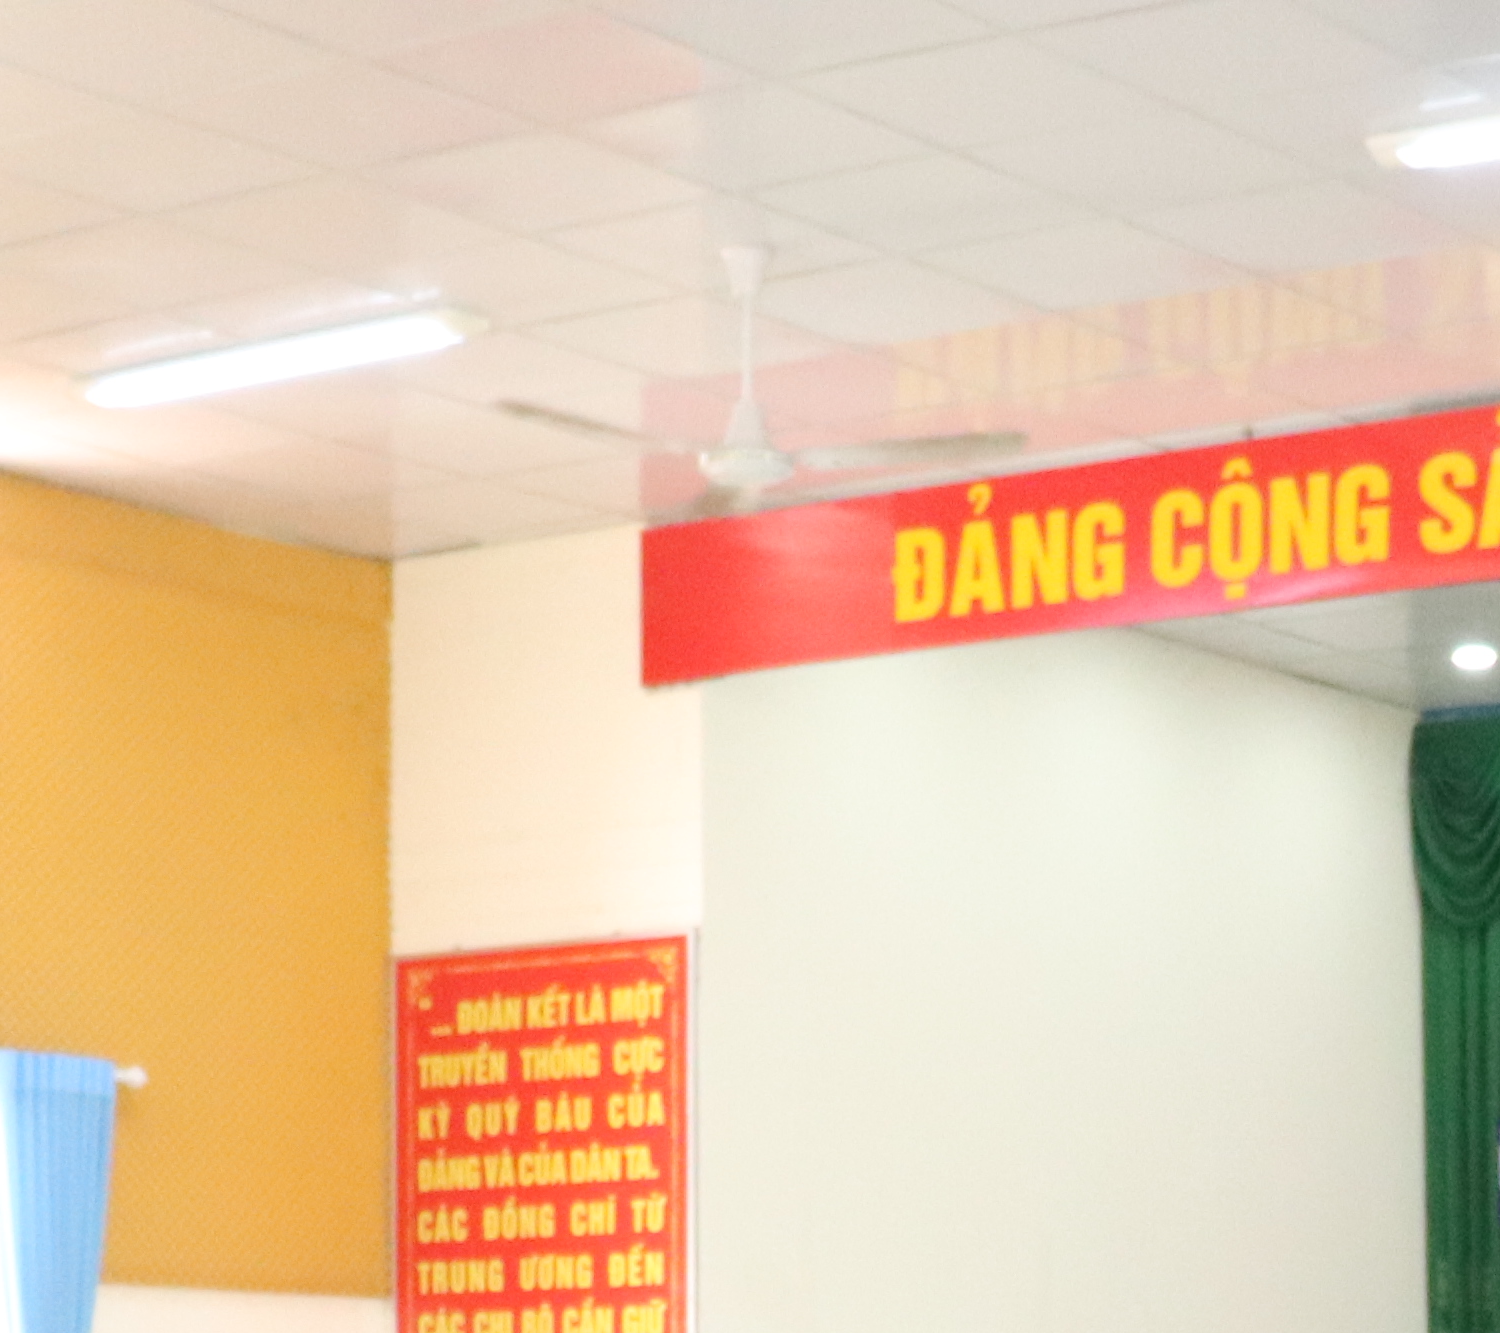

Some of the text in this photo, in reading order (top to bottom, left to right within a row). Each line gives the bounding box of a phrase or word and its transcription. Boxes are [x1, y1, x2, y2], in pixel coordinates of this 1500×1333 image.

[892, 483, 1126, 626] ĐẢNG
[1147, 456, 1390, 602] CỘNG
[527, 984, 571, 1028] KẾT
[575, 984, 606, 1022] LÀ
[611, 980, 665, 1027] MỘT
[520, 1035, 601, 1080] THỐNG
[612, 1035, 665, 1080] CỰC
[535, 1091, 593, 1133] BÁU
[607, 1084, 665, 1128] CỦA
[418, 1142, 660, 1192] ĐẢNG VÀ CỦA DÂN TA.
[418, 1203, 468, 1241] CÁC
[482, 1196, 556, 1239] ĐỒNG
[570, 1194, 617, 1236] CHÍ
[417, 1244, 665, 1295] TRUNG ƯƠNG ĐẾN
